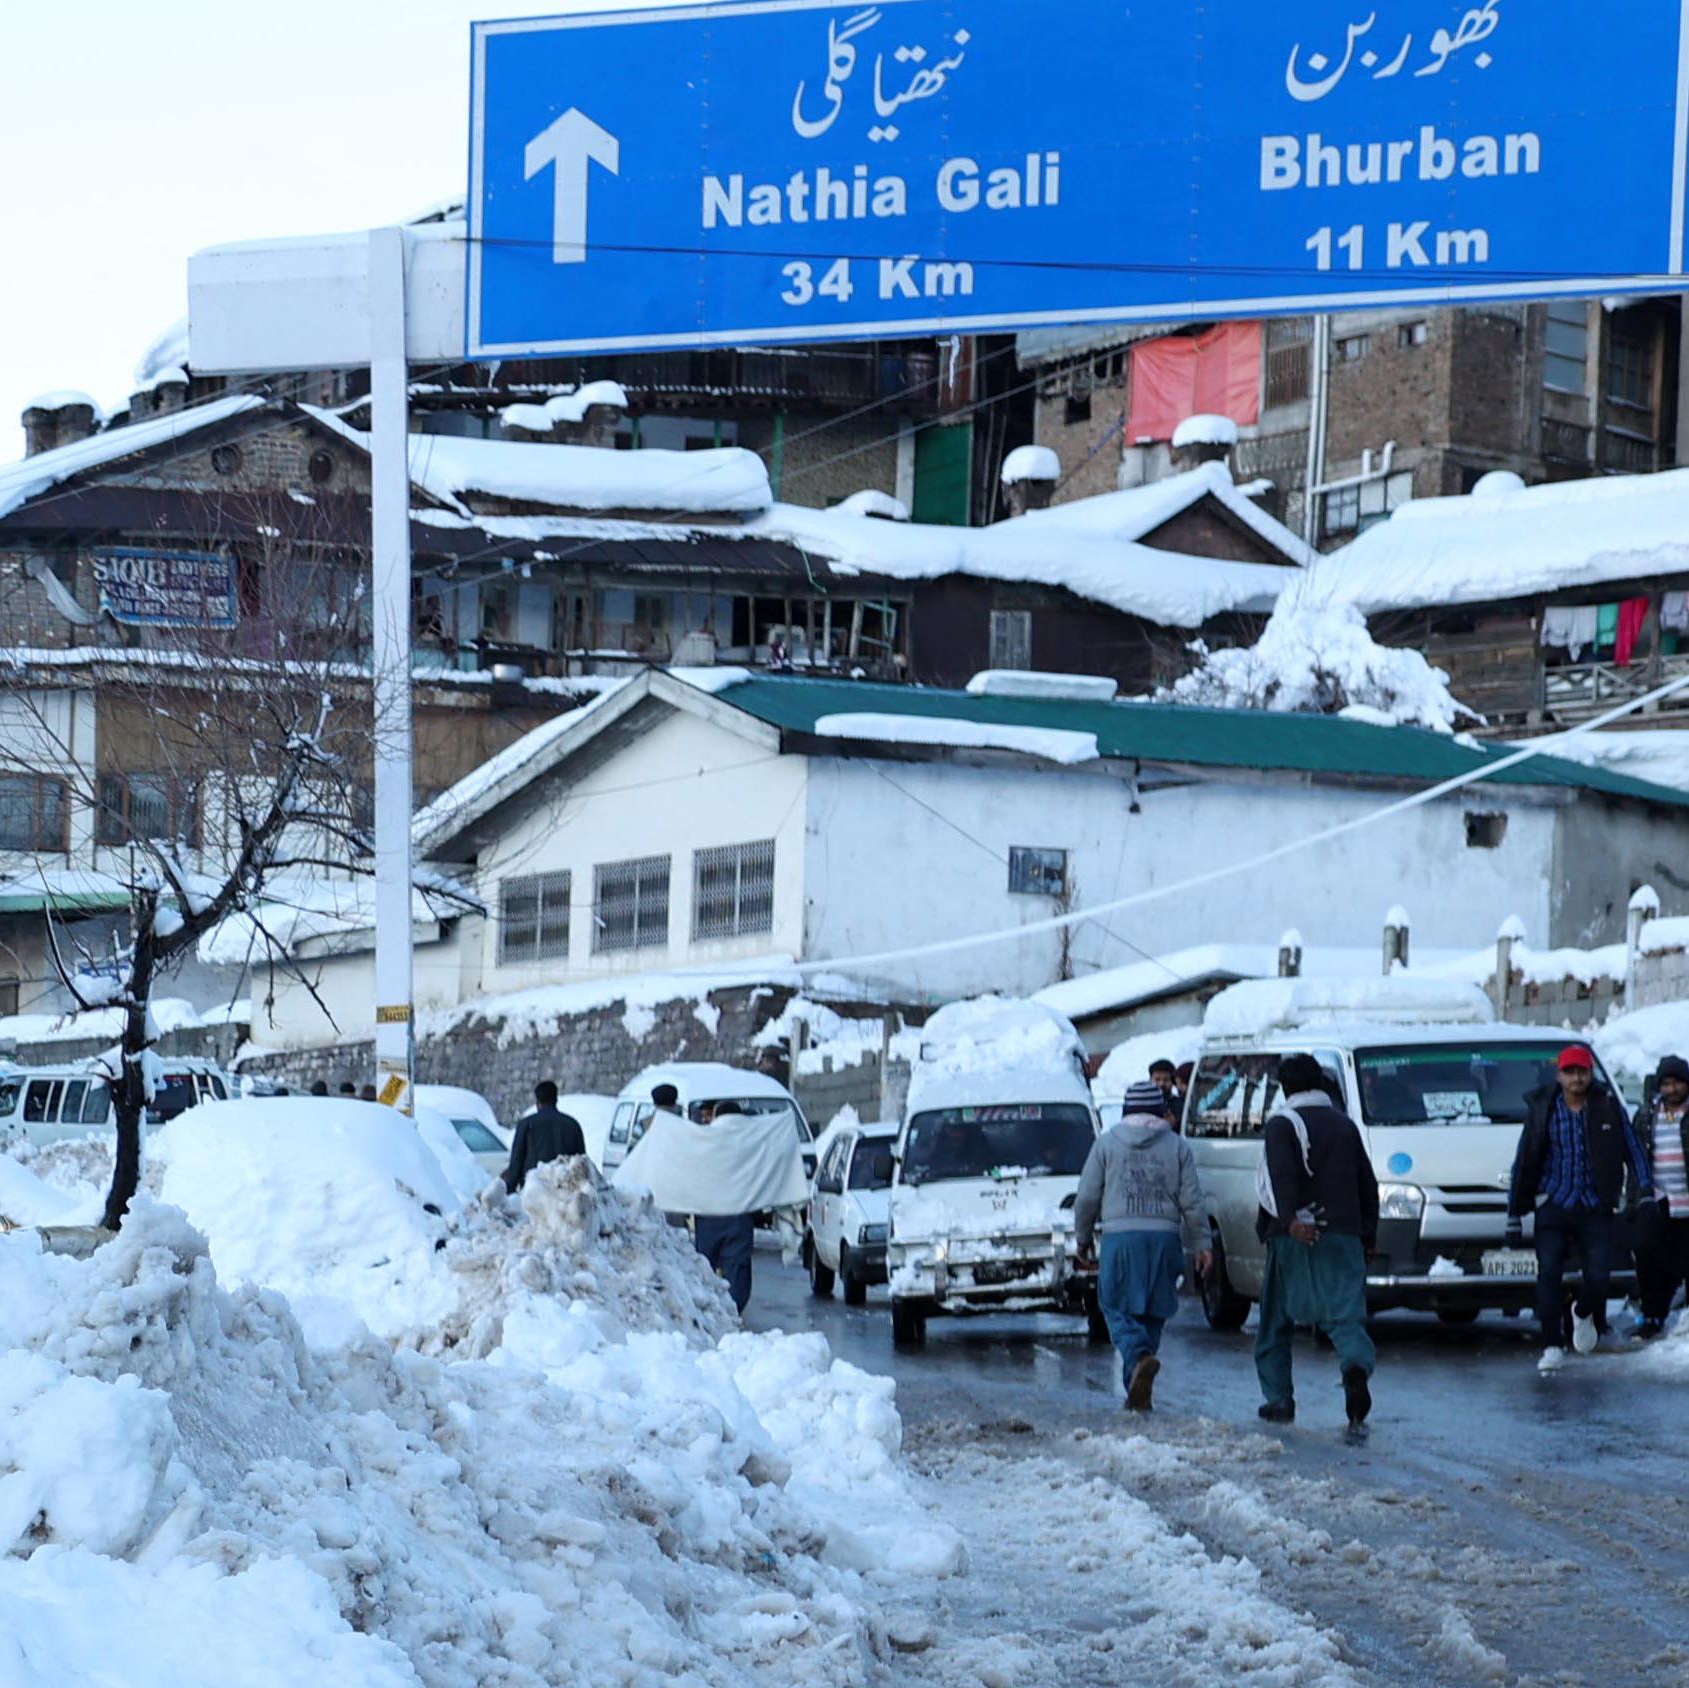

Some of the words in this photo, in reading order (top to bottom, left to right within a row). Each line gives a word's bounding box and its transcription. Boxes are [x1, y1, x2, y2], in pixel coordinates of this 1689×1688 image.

[791, 5, 883, 139] گلی
[701, 164, 907, 229] Nathia
[935, 151, 1060, 213] Gali
[1259, 125, 1541, 191] Bhurban
[1305, 224, 1364, 271] 11
[1386, 221, 1490, 269] Km
[780, 257, 854, 306] 34
[878, 254, 974, 300] Km
